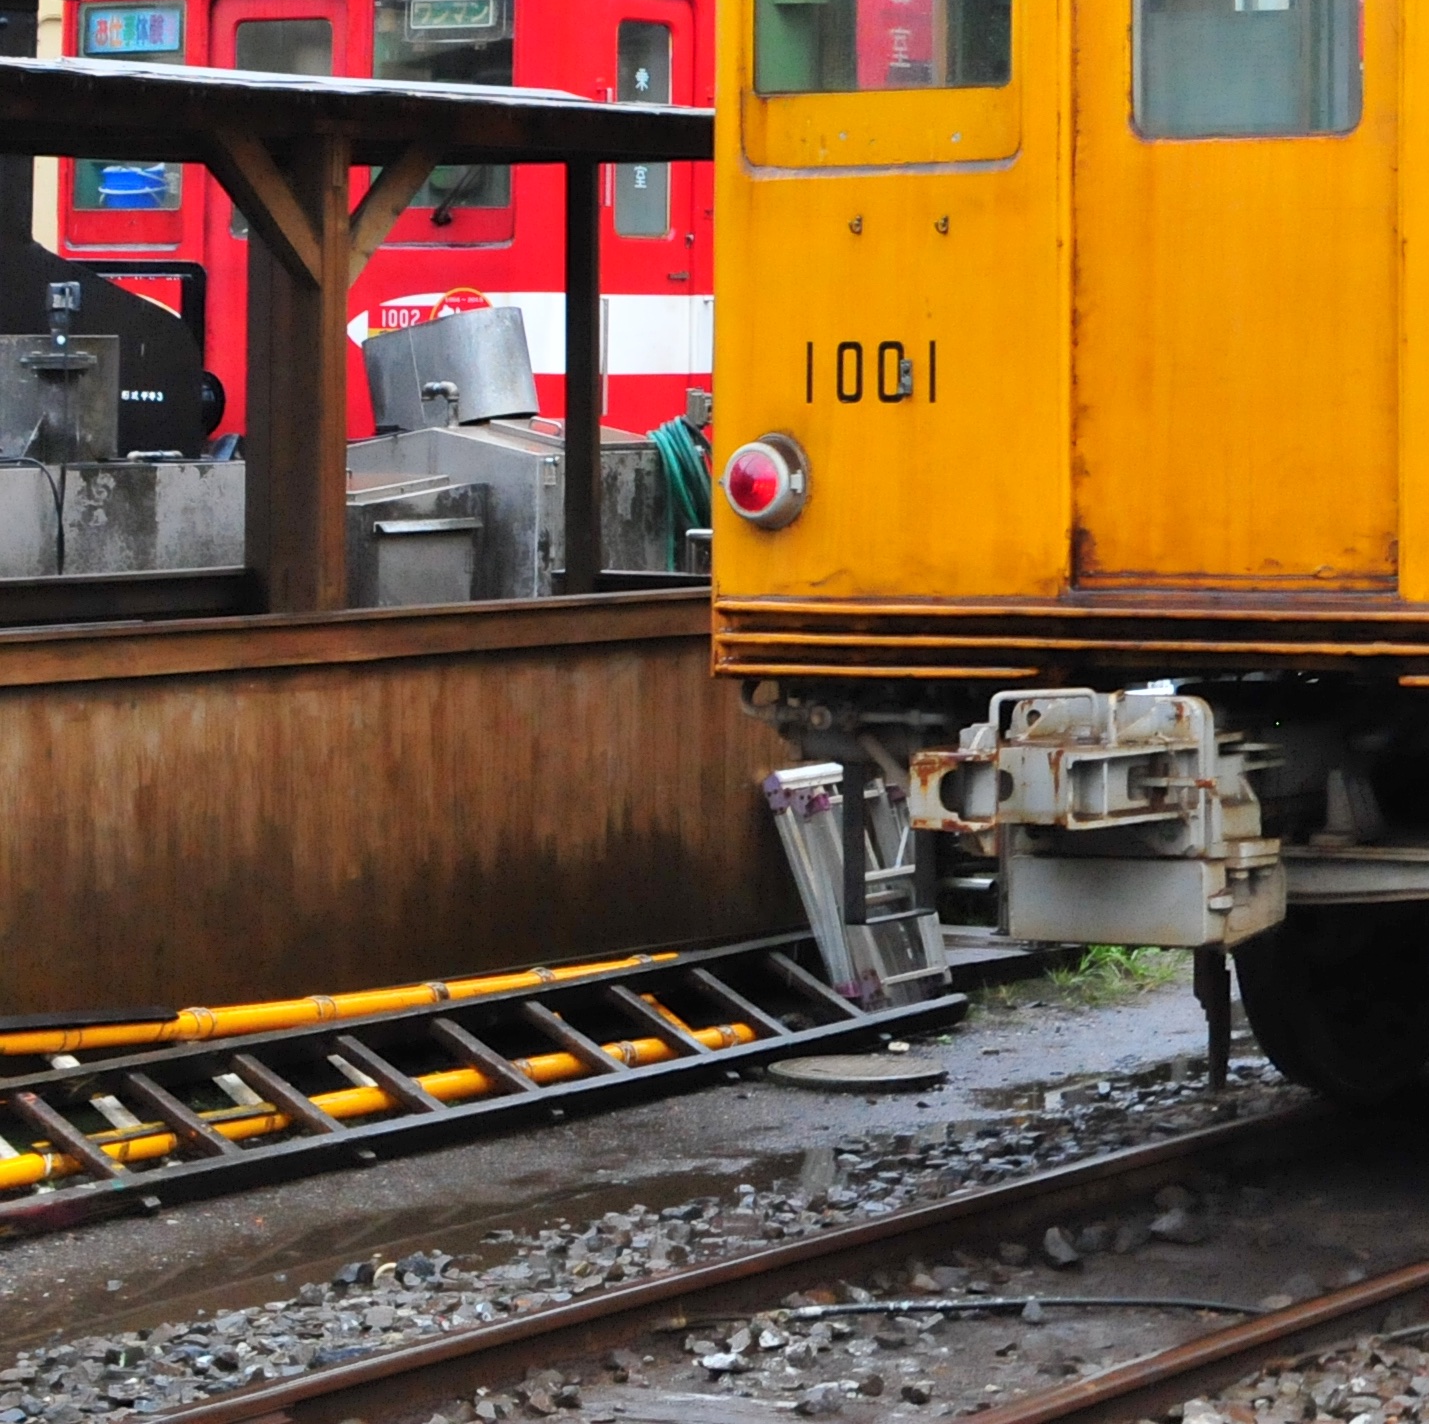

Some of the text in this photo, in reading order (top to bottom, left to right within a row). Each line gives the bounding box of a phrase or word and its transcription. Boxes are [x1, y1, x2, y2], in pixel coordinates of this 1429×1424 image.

[414, 1, 489, 25] ワンマン
[381, 308, 420, 328] 1002
[806, 340, 936, 404] 1001
